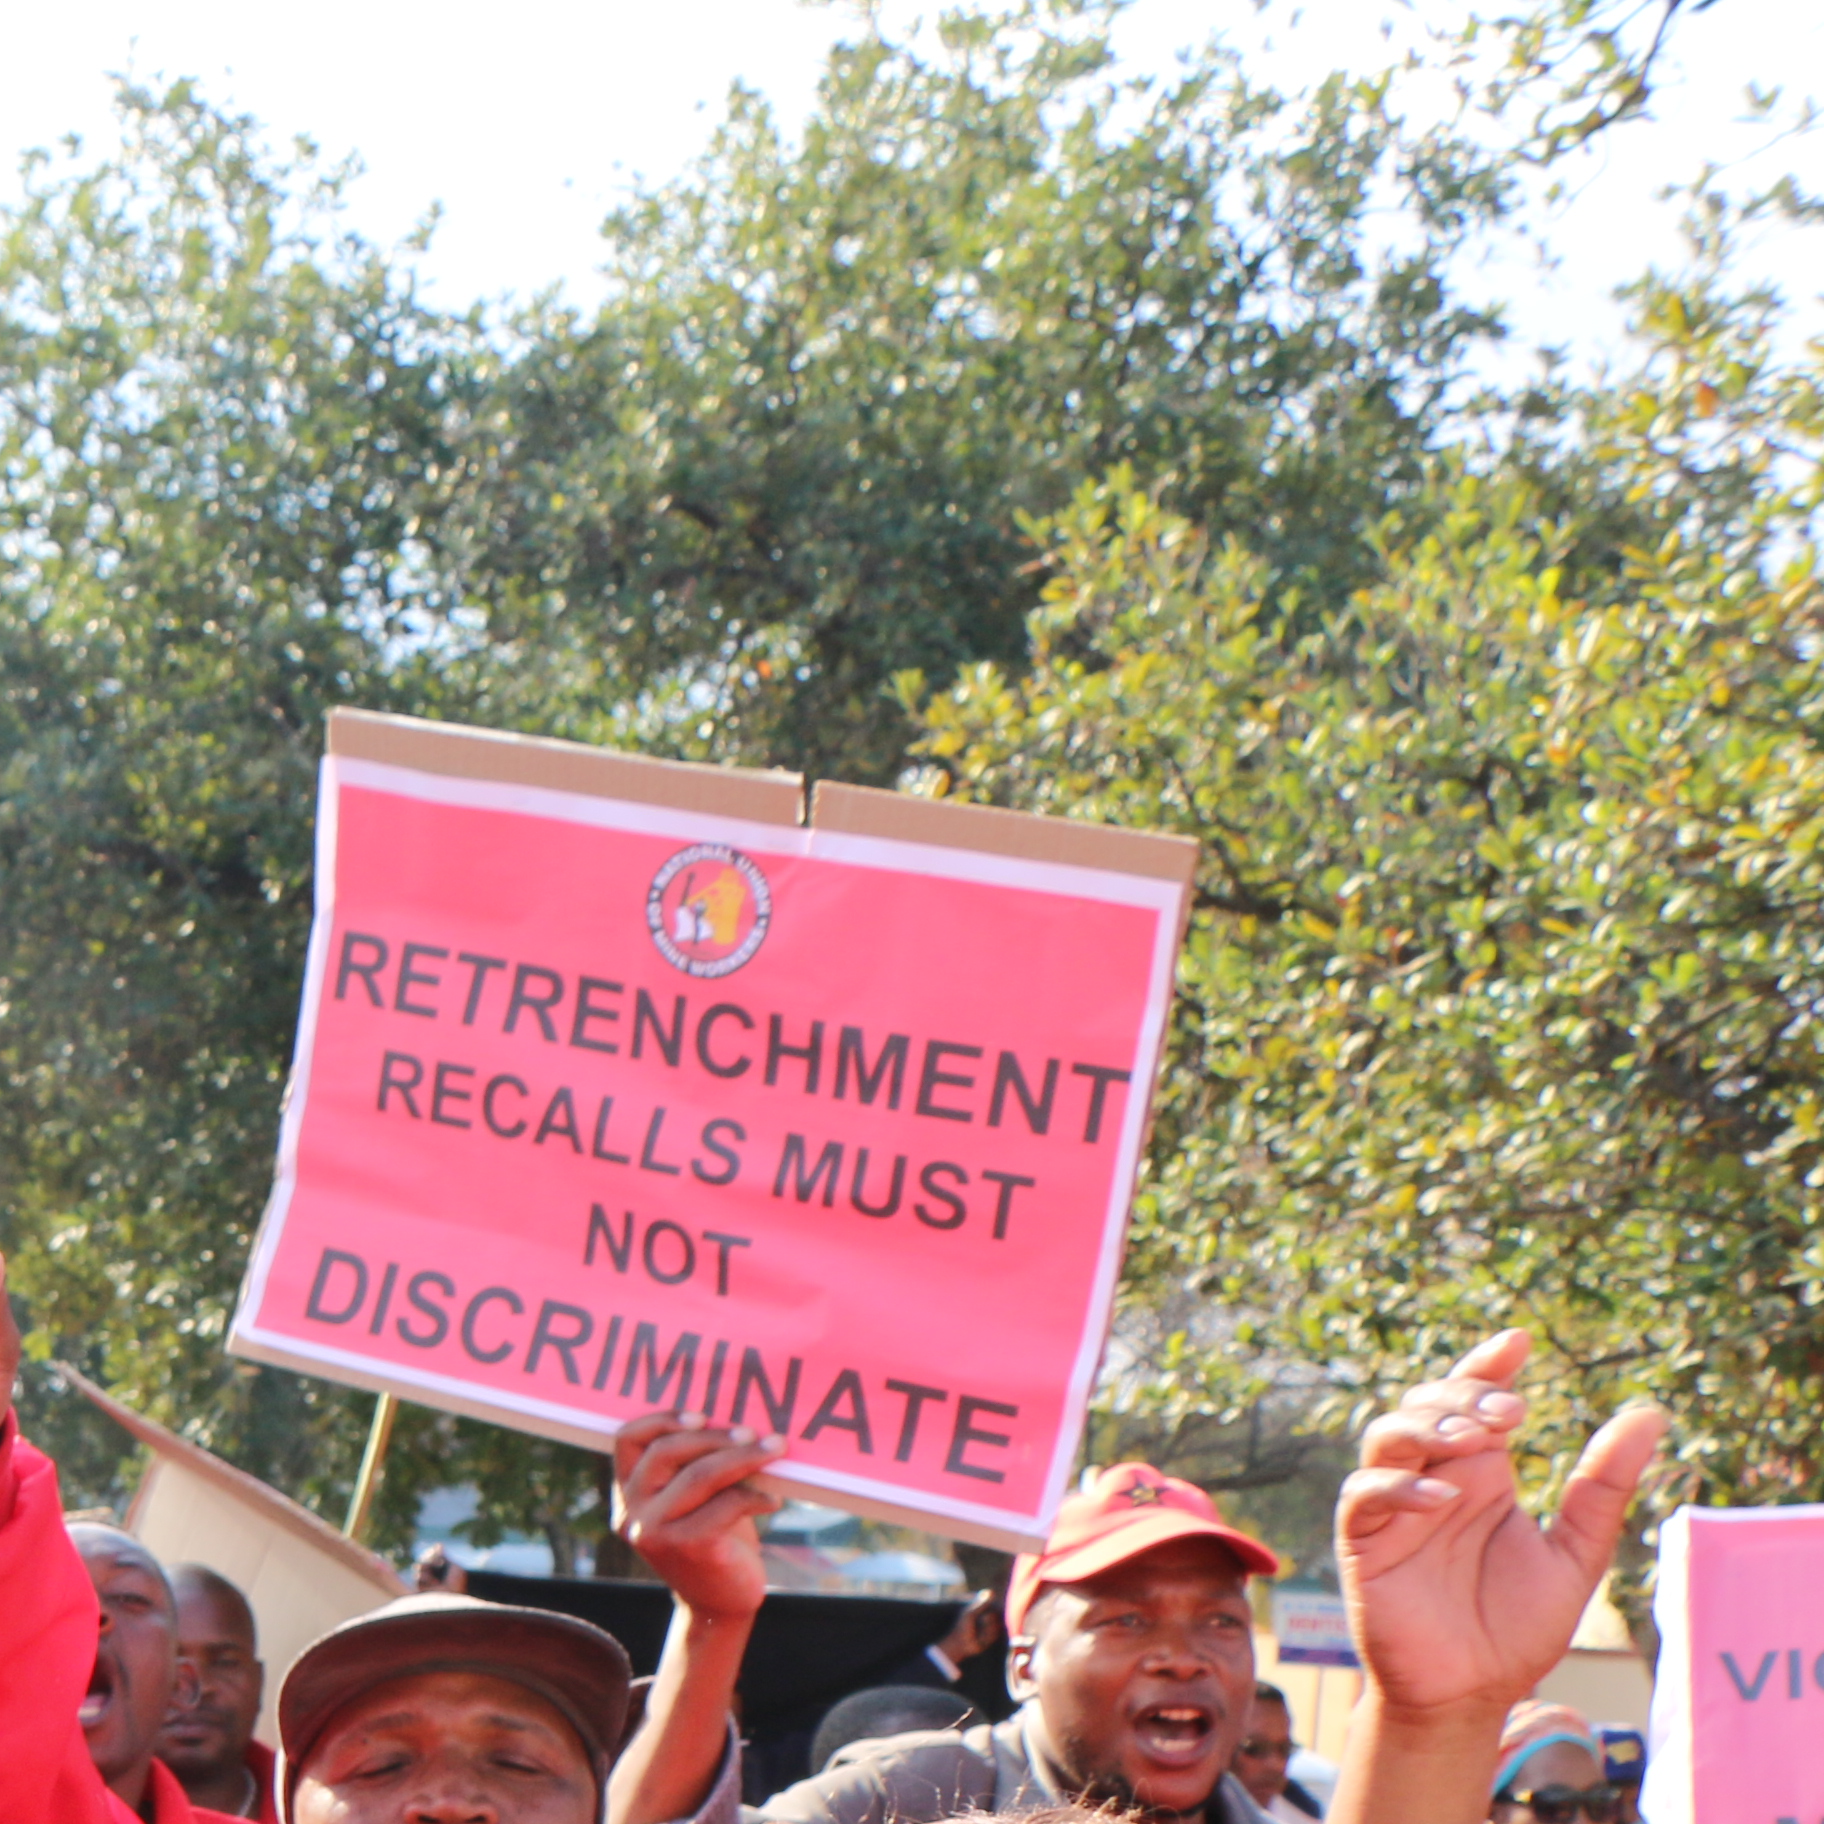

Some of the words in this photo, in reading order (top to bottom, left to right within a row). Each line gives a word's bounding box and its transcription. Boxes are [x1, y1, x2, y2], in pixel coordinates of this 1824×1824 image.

[333, 929, 1134, 1146] RETRENCHMENT
[375, 1050, 749, 1187] RECALLS
[771, 1132, 1036, 1241] MUST
[582, 1202, 751, 1298] NOT
[303, 1247, 1021, 1485] DISCRIMINATE
